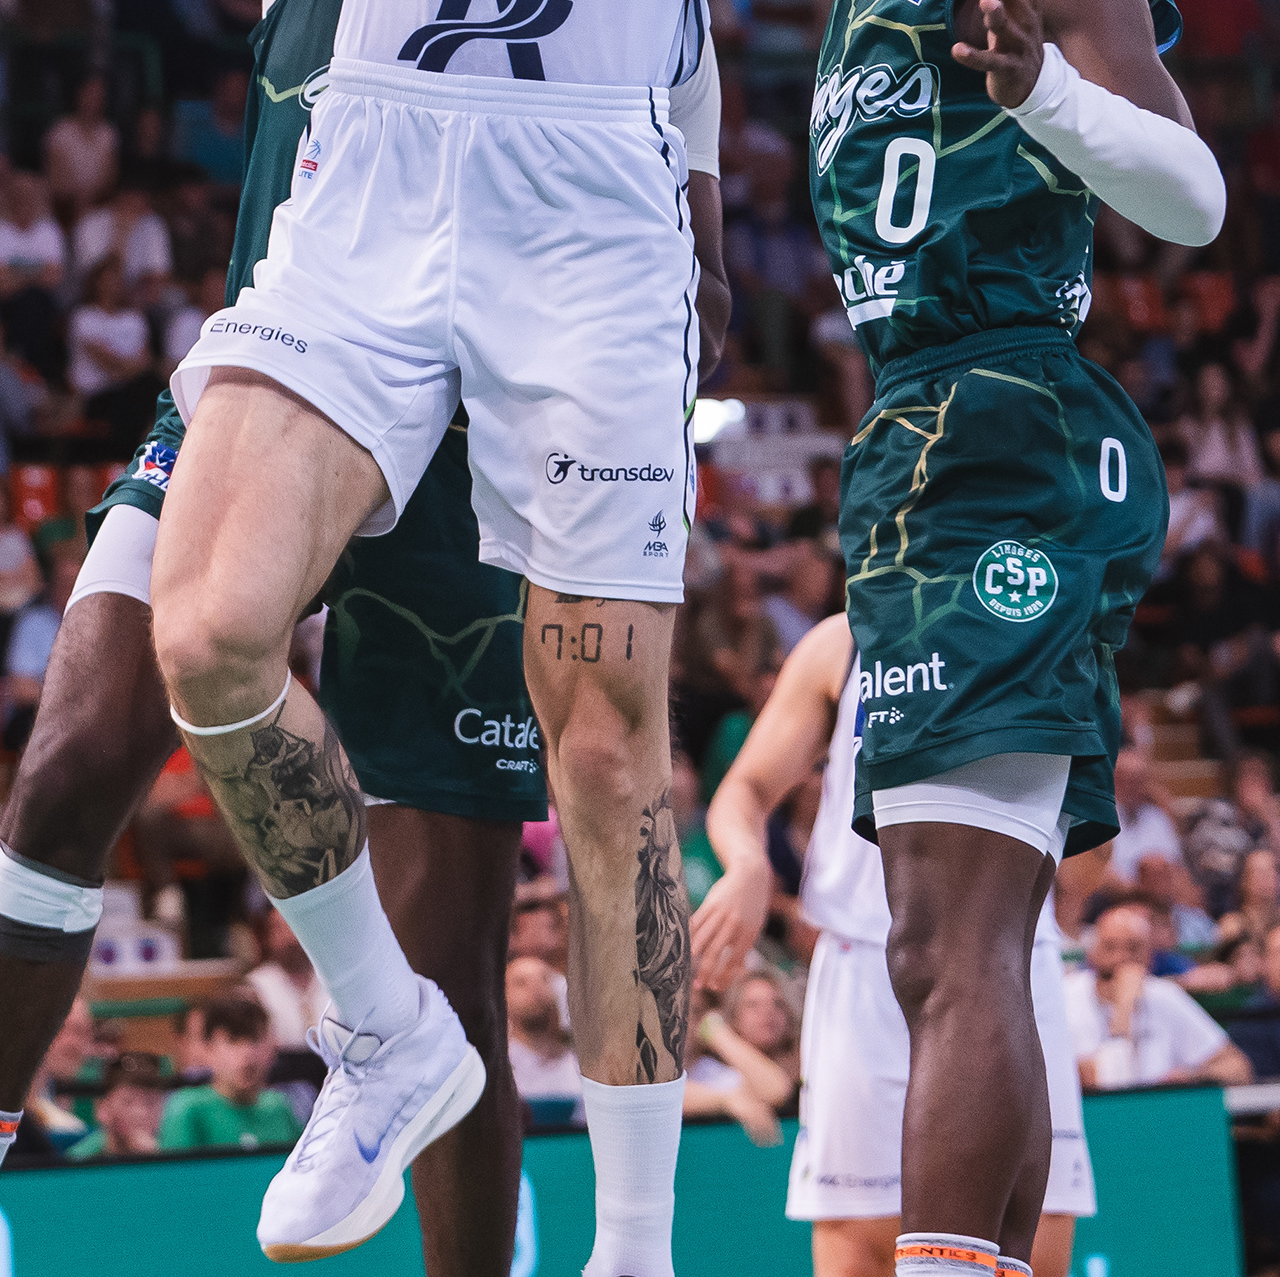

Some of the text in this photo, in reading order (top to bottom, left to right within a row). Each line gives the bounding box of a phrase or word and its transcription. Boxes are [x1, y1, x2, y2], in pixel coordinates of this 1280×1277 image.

[875, 136, 937, 244] 0
[210, 318, 308, 353] Energies
[578, 464, 675, 482] transdev
[1099, 437, 1127, 503] 0
[991, 544, 1041, 562] LIMOGES
[984, 556, 1048, 597] CSP
[988, 598, 1022, 617] DEPUIS
